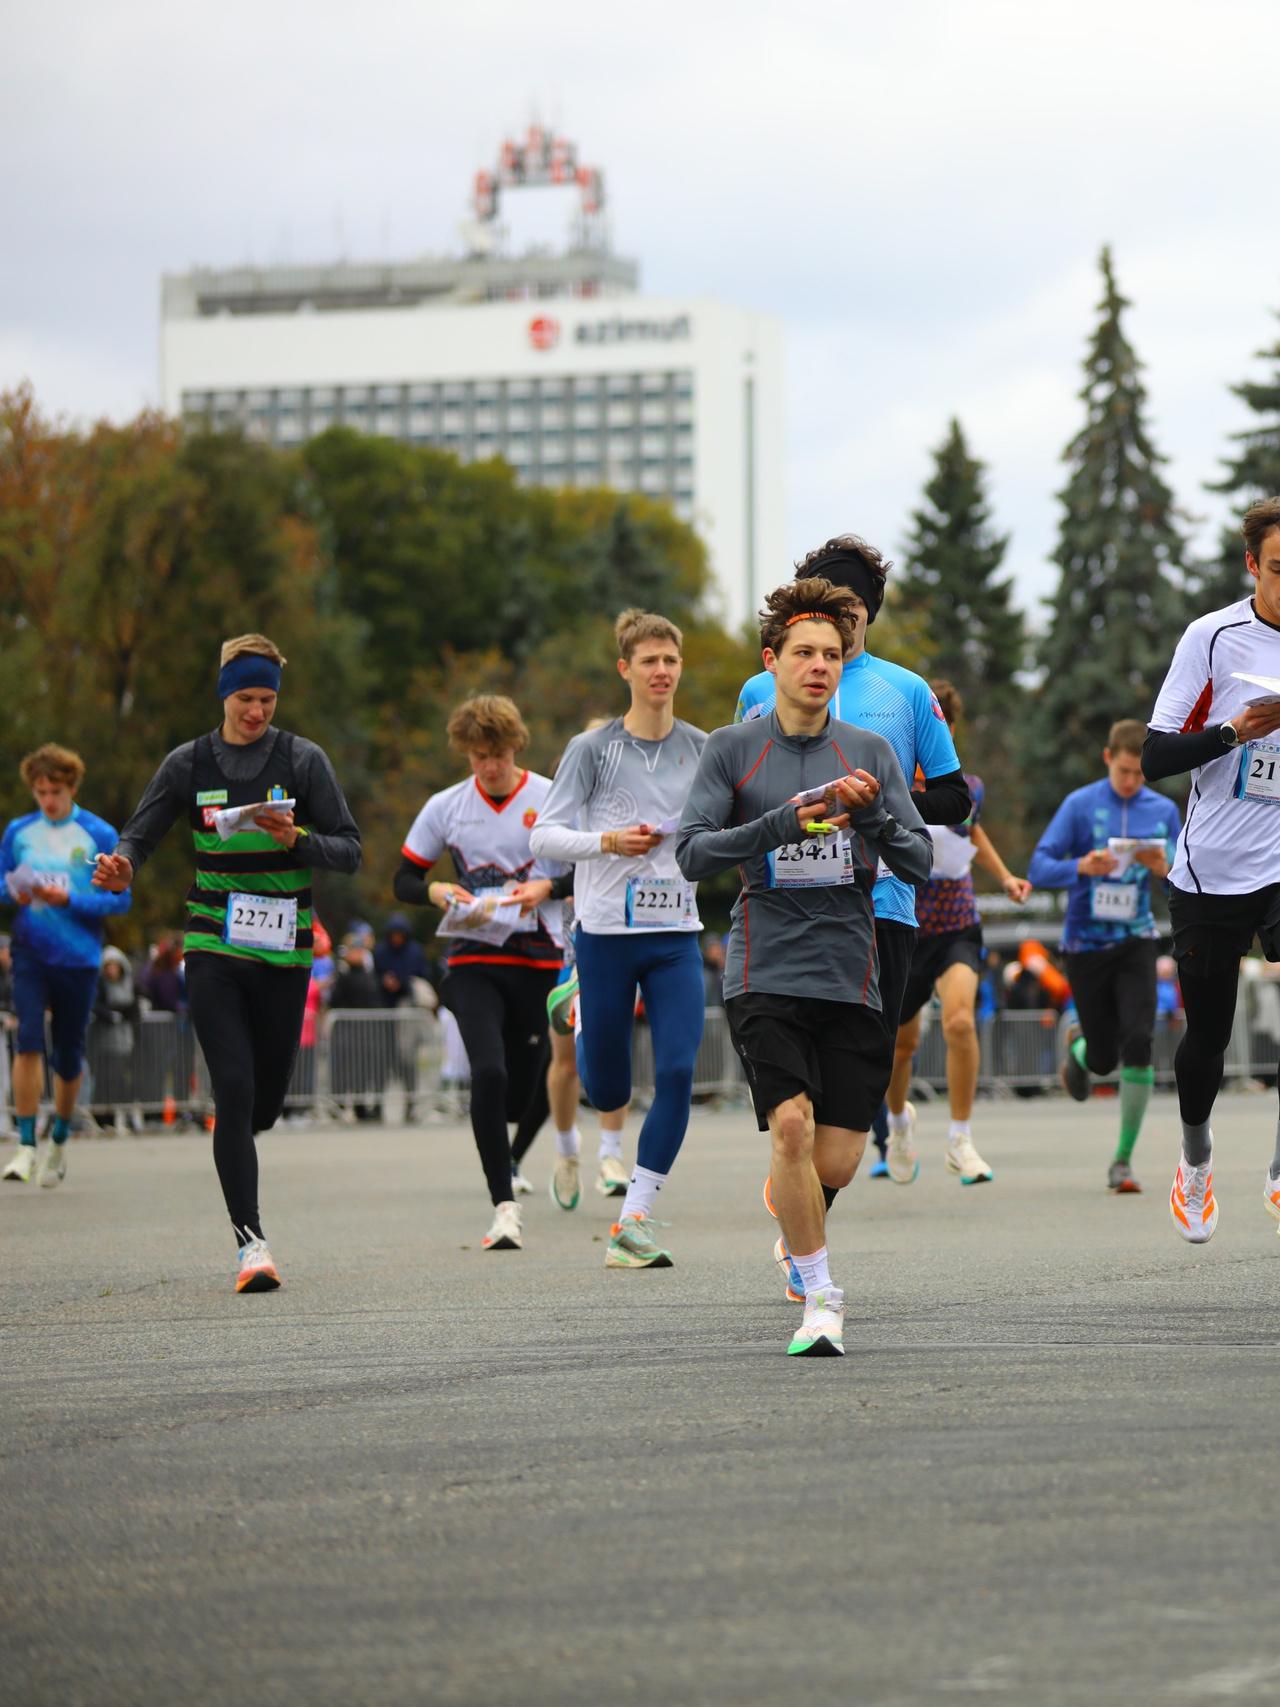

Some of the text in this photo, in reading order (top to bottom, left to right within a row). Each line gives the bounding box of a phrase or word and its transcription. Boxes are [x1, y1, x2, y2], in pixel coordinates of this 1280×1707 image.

[575, 312, 691, 345] azimut
[635, 891, 682, 908] 222.1
[233, 907, 284, 929] 227.1
